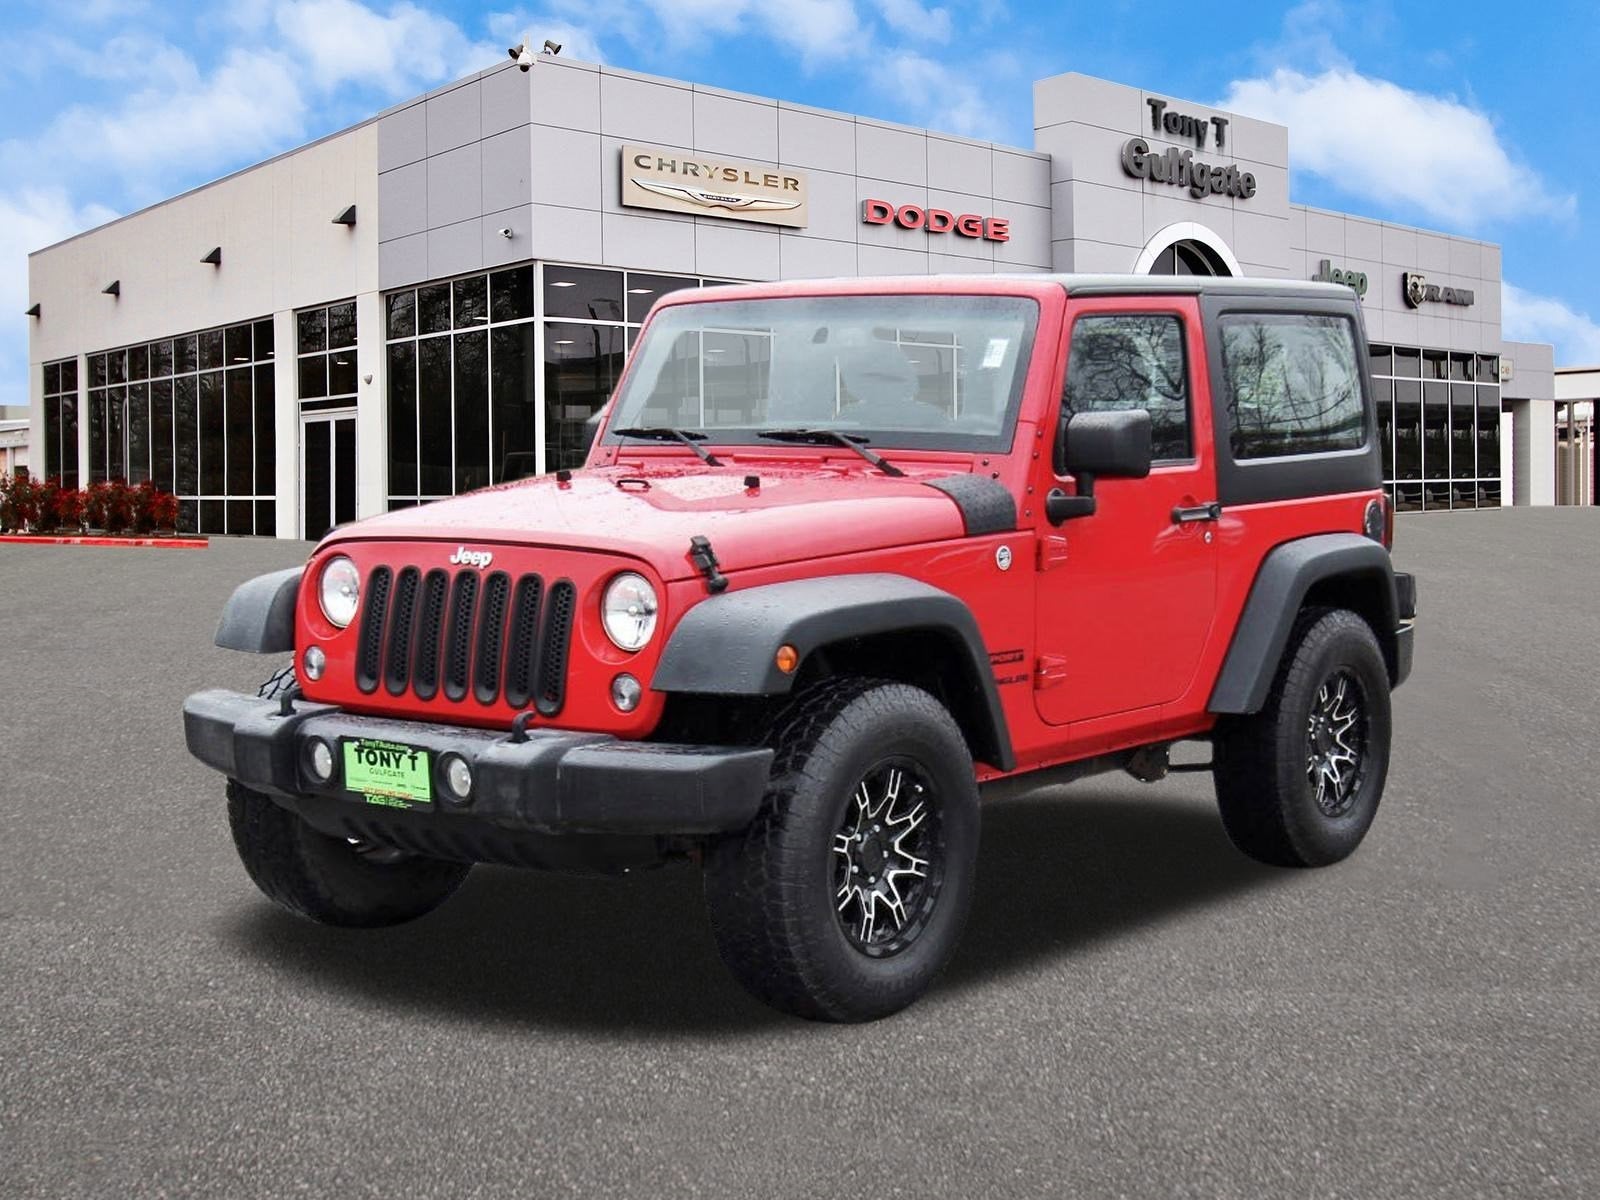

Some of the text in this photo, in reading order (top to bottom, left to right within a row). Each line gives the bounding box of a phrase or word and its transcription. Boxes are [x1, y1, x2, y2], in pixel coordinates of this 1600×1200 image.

[1146, 98, 1229, 147] Tony T
[633, 154, 800, 192] CHRYSLER
[1121, 138, 1256, 199] Gulfgate
[862, 198, 1011, 242] DODGE
[1312, 259, 1367, 298] Jeep
[1425, 284, 1474, 306] RAM
[450, 546, 493, 569] Jeep
[354, 747, 418, 772] TONY T
[369, 767, 405, 779] GULFGATE
